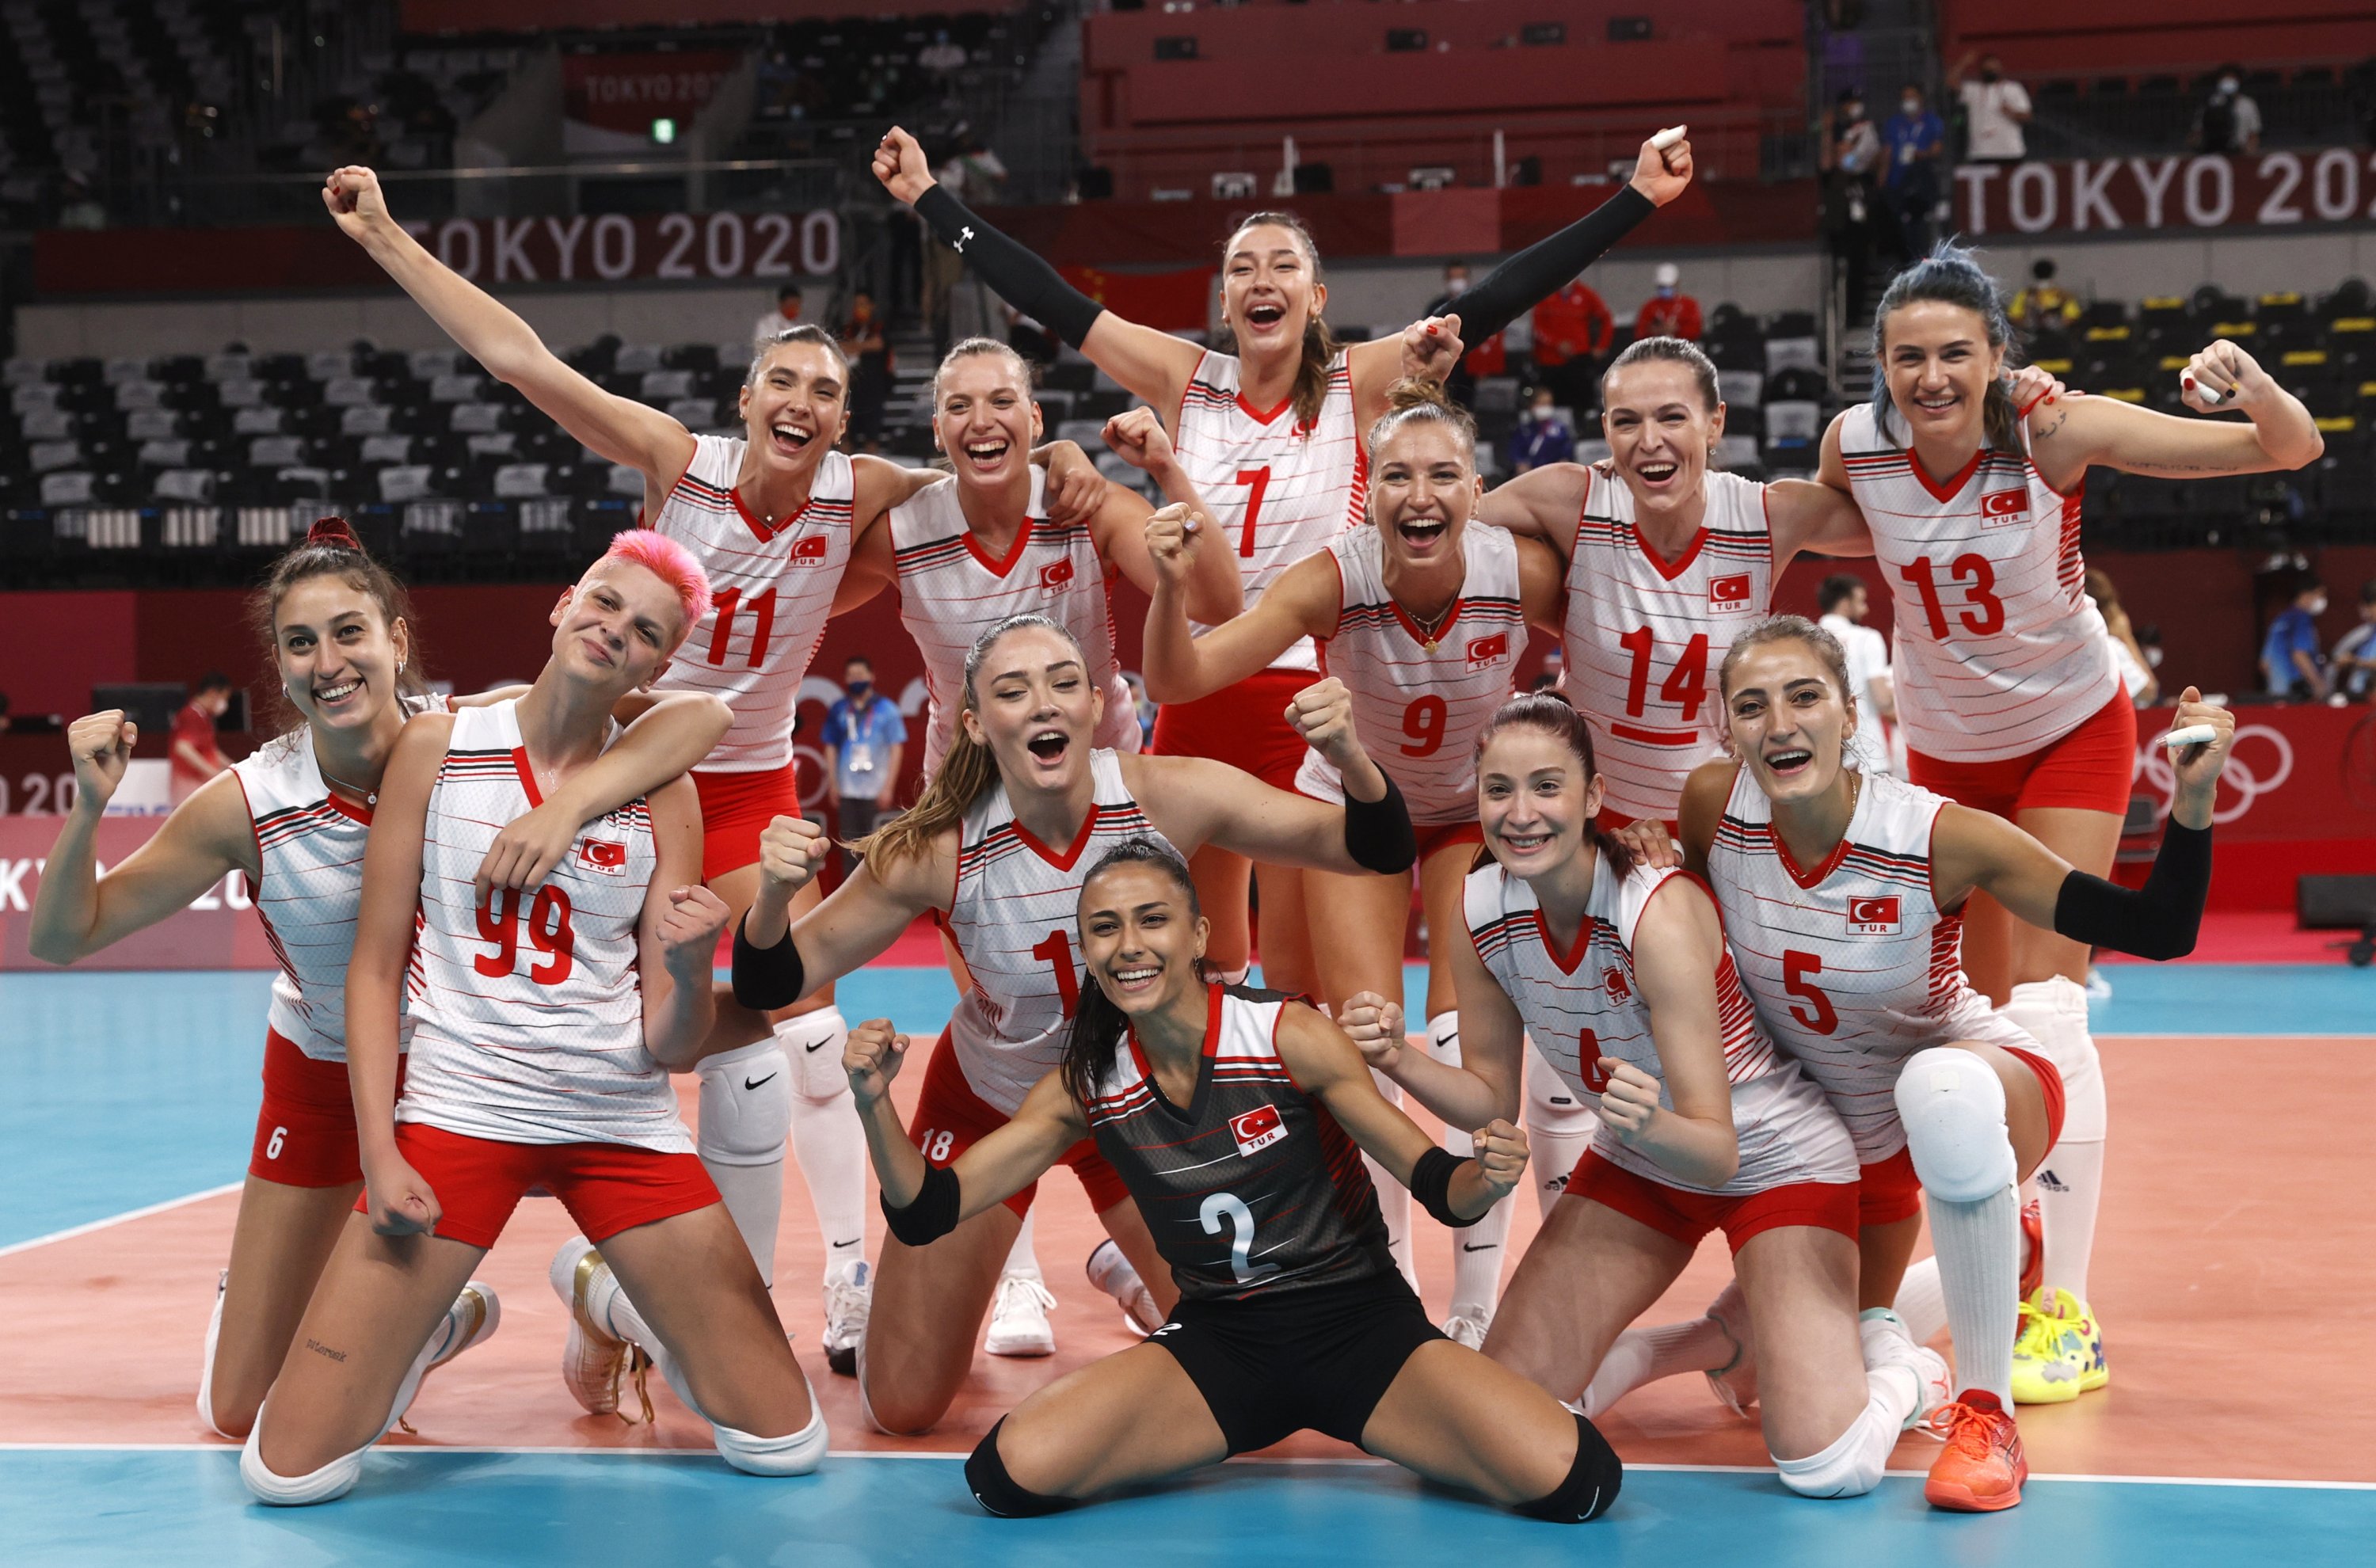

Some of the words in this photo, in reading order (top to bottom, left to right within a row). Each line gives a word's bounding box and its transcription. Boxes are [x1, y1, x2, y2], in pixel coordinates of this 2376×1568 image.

[1955, 154, 2234, 234] TOKYO
[2257, 148, 2376, 225] 20
[657, 209, 840, 279] 2020
[1236, 466, 1270, 558] 7
[1992, 514, 2019, 525] TUR
[707, 587, 777, 668] 11
[1716, 601, 1741, 611] TUR
[1901, 553, 2005, 641] 13
[1475, 657, 1498, 668] TUR
[1620, 625, 1708, 721] 14
[1400, 695, 1448, 758] 9
[587, 862, 615, 873] TUR
[474, 883, 575, 985] 99
[1859, 924, 1887, 933] TUR
[1033, 930, 1080, 1022] 1
[1611, 991, 1627, 1003] TU
[1784, 950, 1839, 1036] 5
[266, 1126, 287, 1159] 6
[921, 1128, 954, 1161] 18
[1247, 1132, 1276, 1149] TUR
[1200, 1192, 1281, 1284] 2
